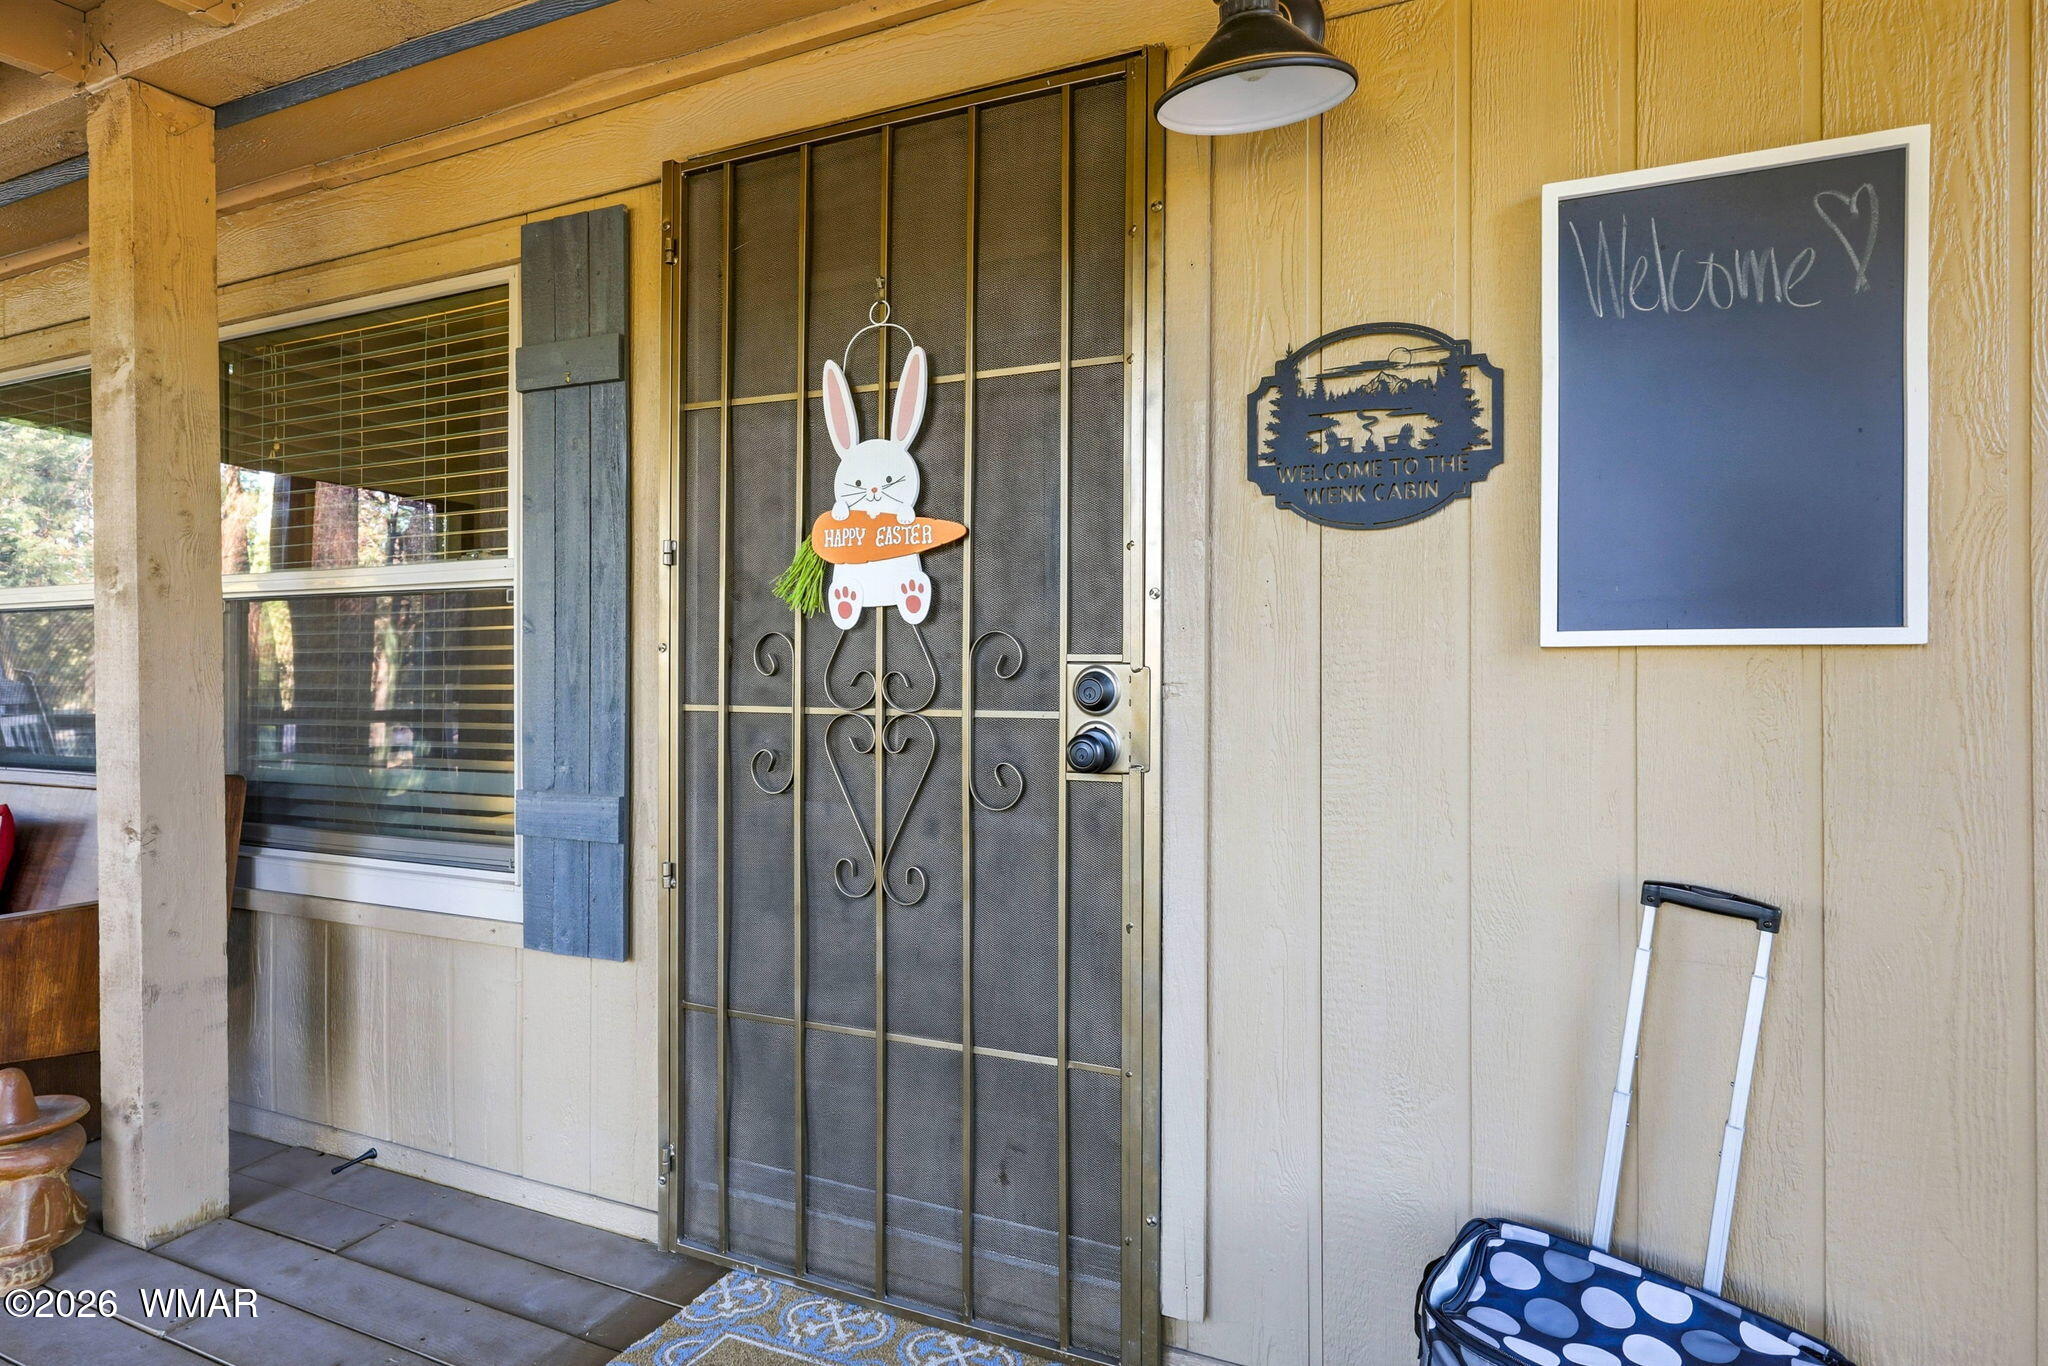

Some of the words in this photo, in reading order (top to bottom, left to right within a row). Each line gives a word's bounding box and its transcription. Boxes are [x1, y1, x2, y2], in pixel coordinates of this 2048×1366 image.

[1569, 214, 1821, 318] Welcome
[1276, 458, 1382, 484] WELCOME
[1389, 456, 1418, 476] TO
[1425, 453, 1470, 473] THE
[1304, 482, 1367, 505] WENK
[1373, 480, 1439, 500] CABIN
[824, 527, 866, 547] HAPPY
[875, 523, 933, 547] EASTER
